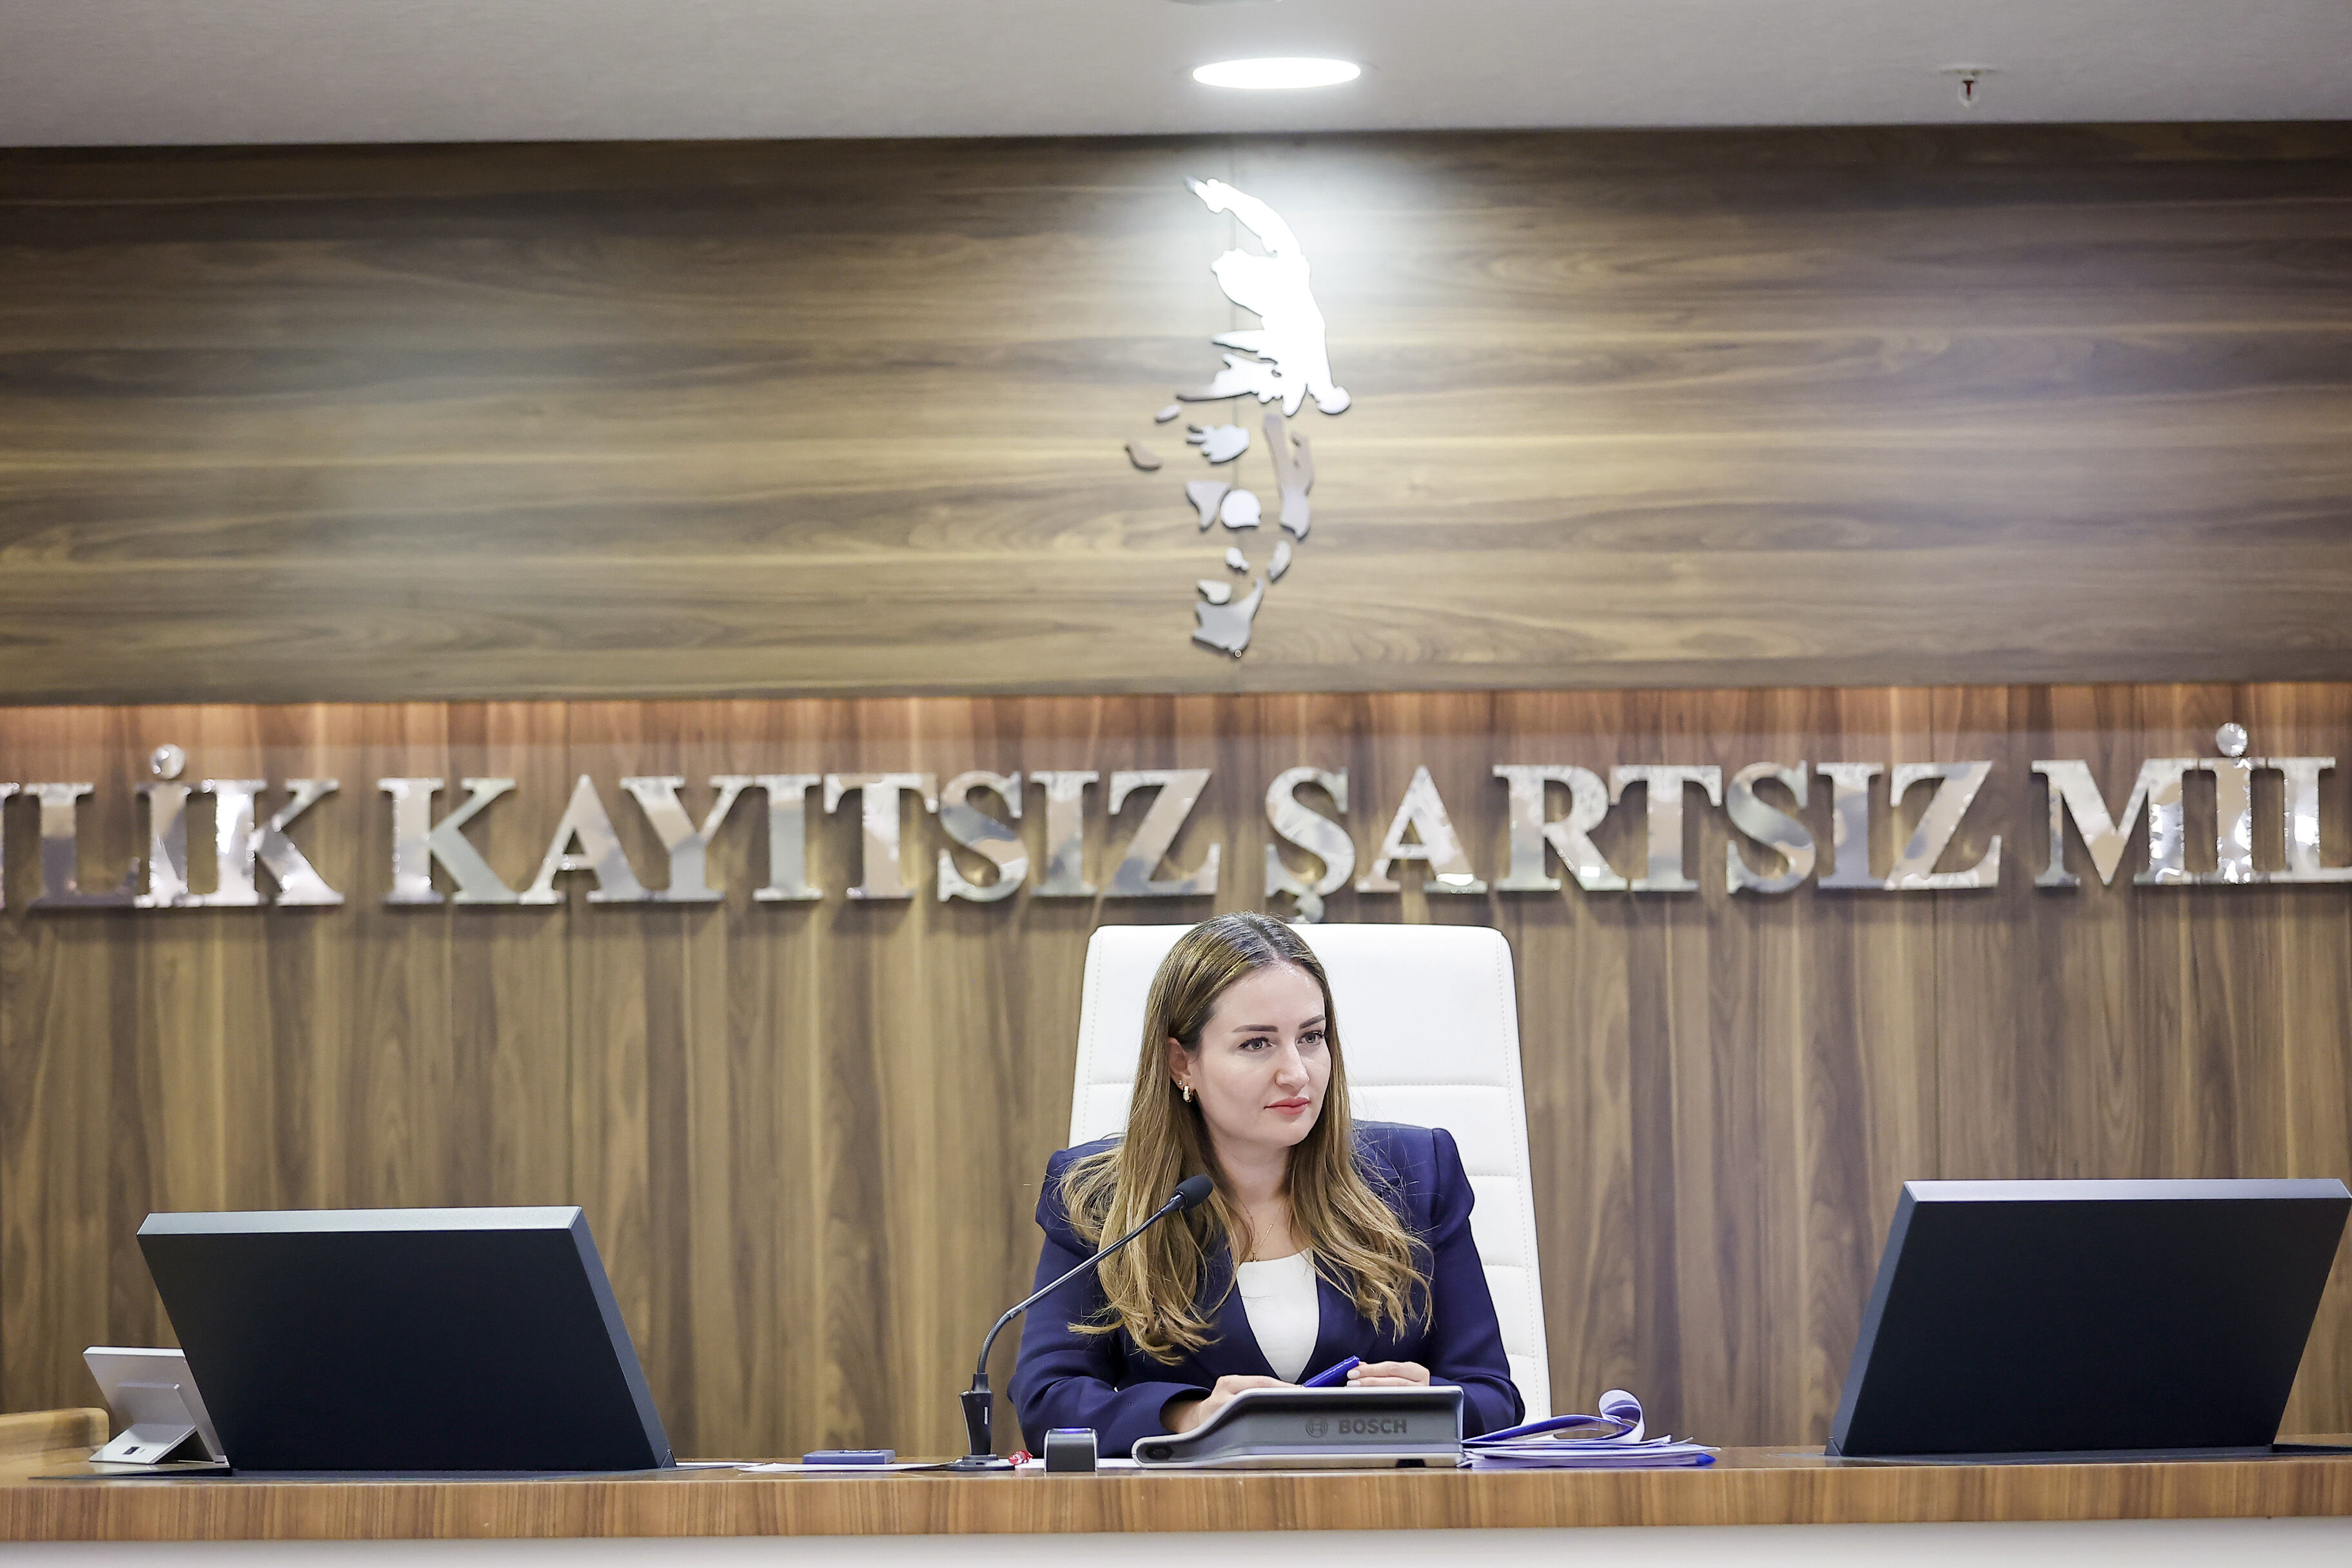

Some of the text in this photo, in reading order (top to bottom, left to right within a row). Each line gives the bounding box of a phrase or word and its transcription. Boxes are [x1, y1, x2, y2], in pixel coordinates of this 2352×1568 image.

[0, 722, 2352, 923] LİK KAYITSIZ ŞARTSIZ MİL
[1338, 1418, 1407, 1435] BOSCH
